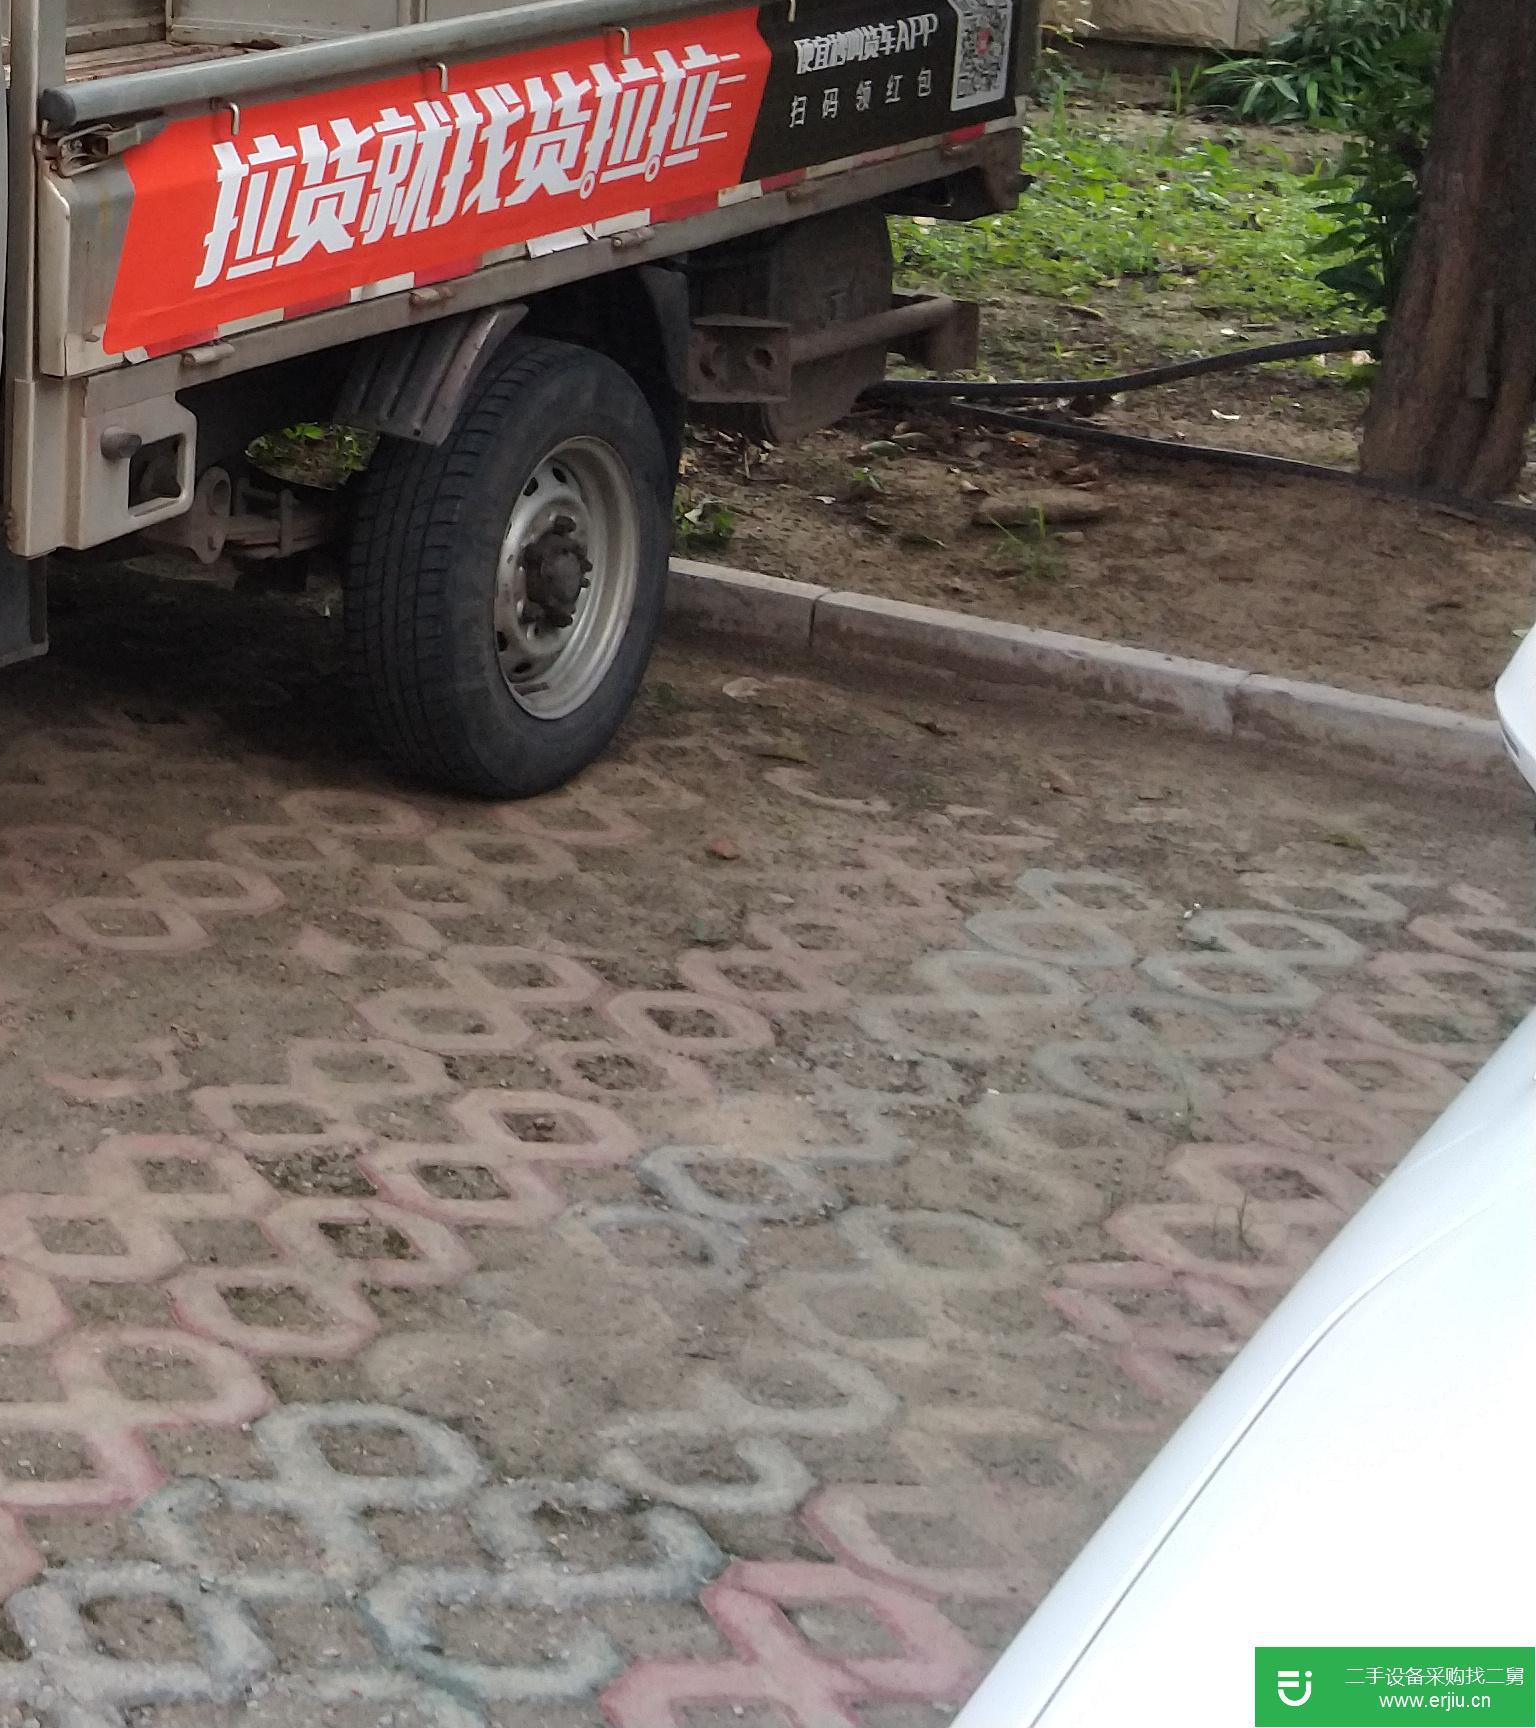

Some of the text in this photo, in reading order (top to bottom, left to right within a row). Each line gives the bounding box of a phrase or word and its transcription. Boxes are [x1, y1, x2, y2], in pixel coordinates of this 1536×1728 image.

[194, 44, 733, 289] 拉货就找货拉拉
[789, 66, 932, 129] 扫码领红包
